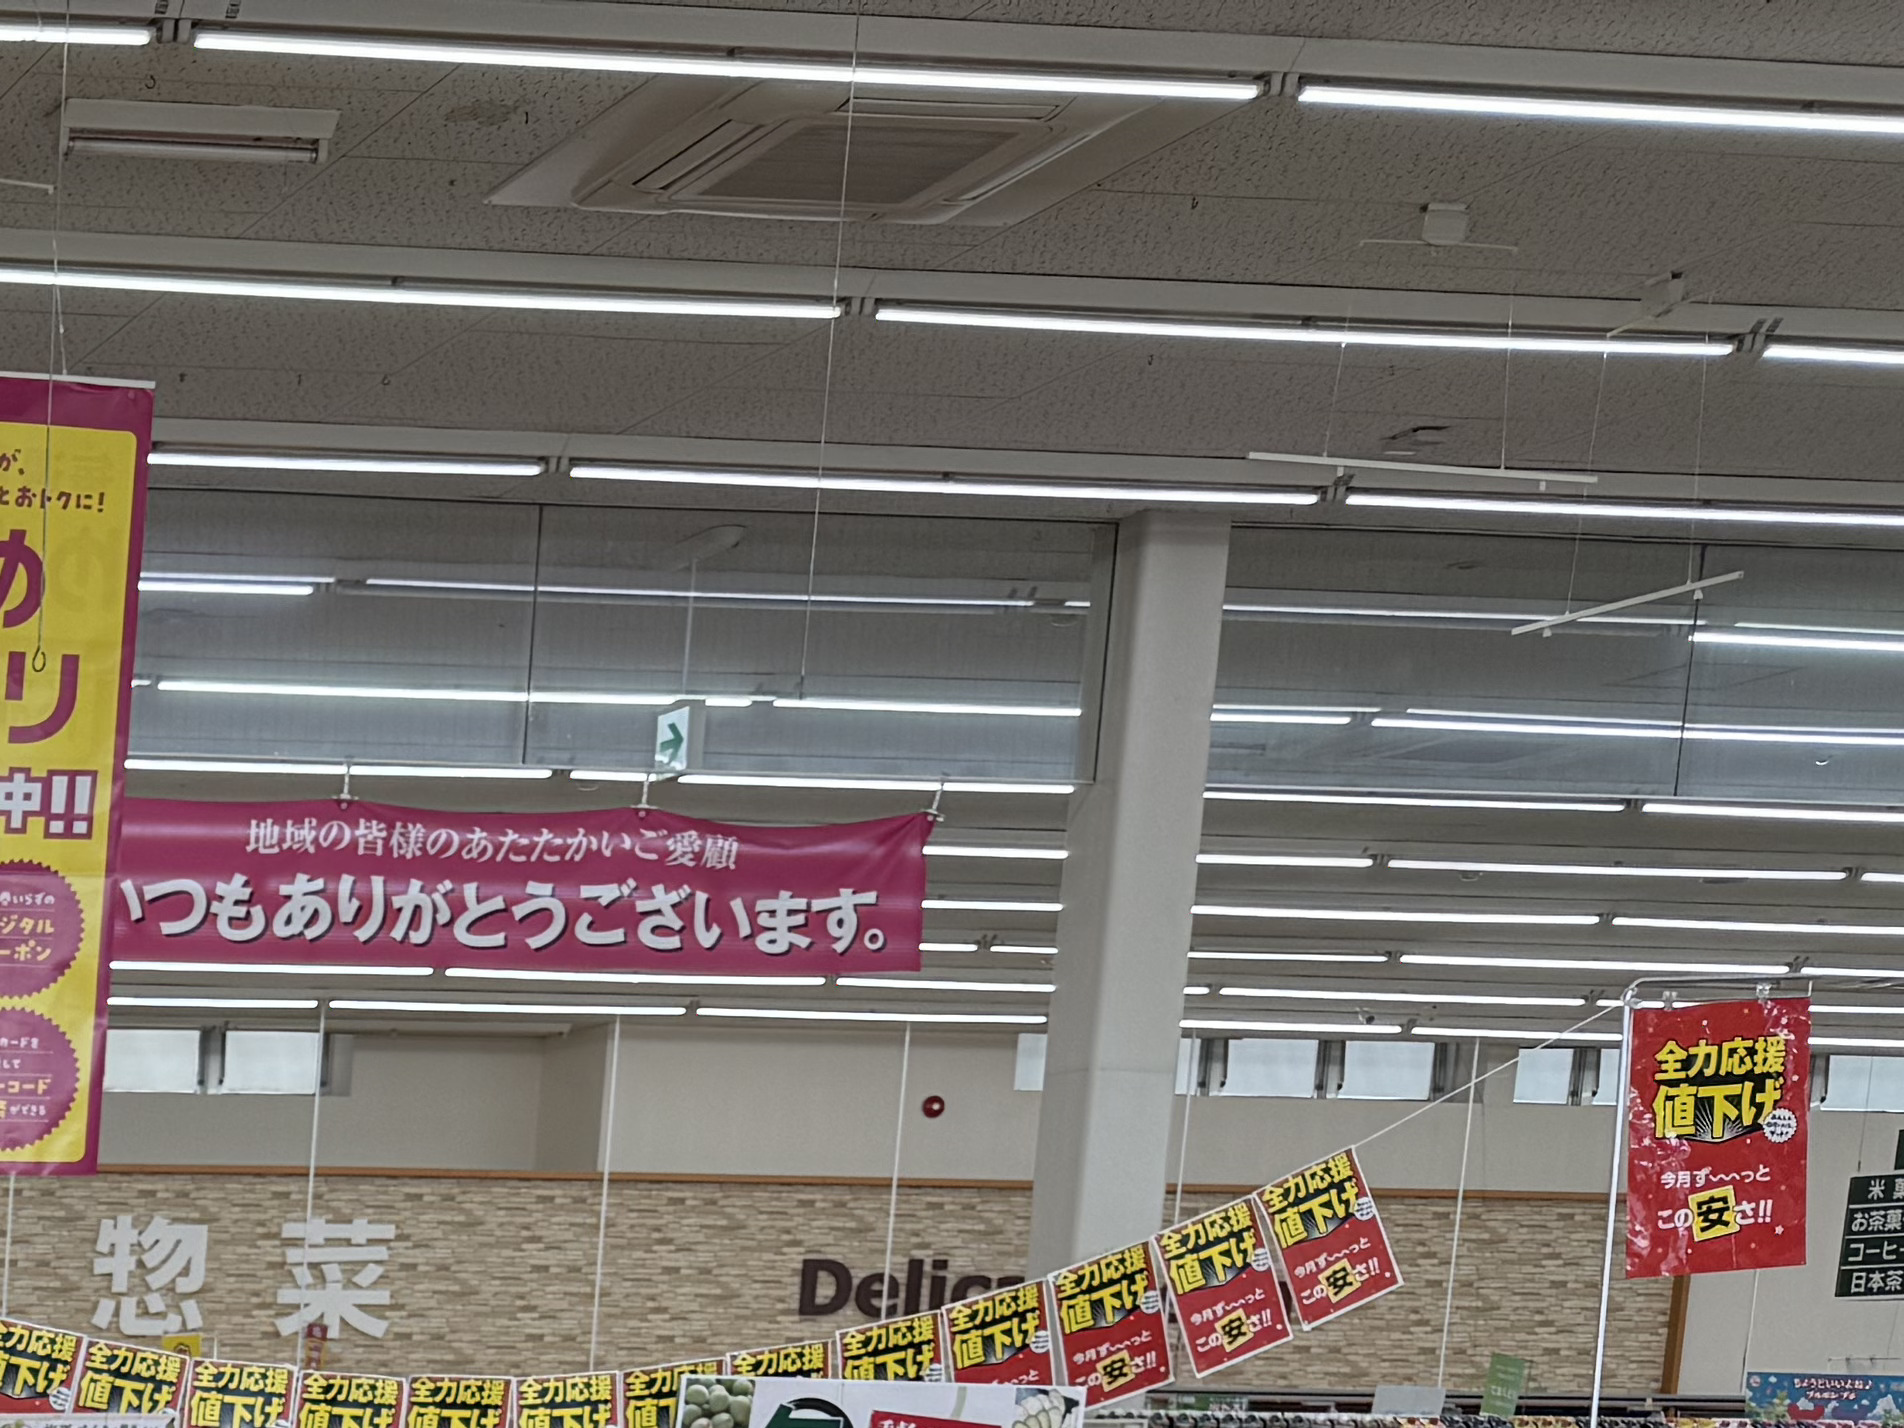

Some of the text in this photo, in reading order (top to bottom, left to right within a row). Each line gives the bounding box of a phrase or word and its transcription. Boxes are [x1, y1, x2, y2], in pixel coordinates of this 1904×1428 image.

[246, 817, 740, 872] 地域の皆様のあたたかいご愛顧
[85, 1341, 182, 1383] 全力応援
[193, 1359, 289, 1396] 全力応援
